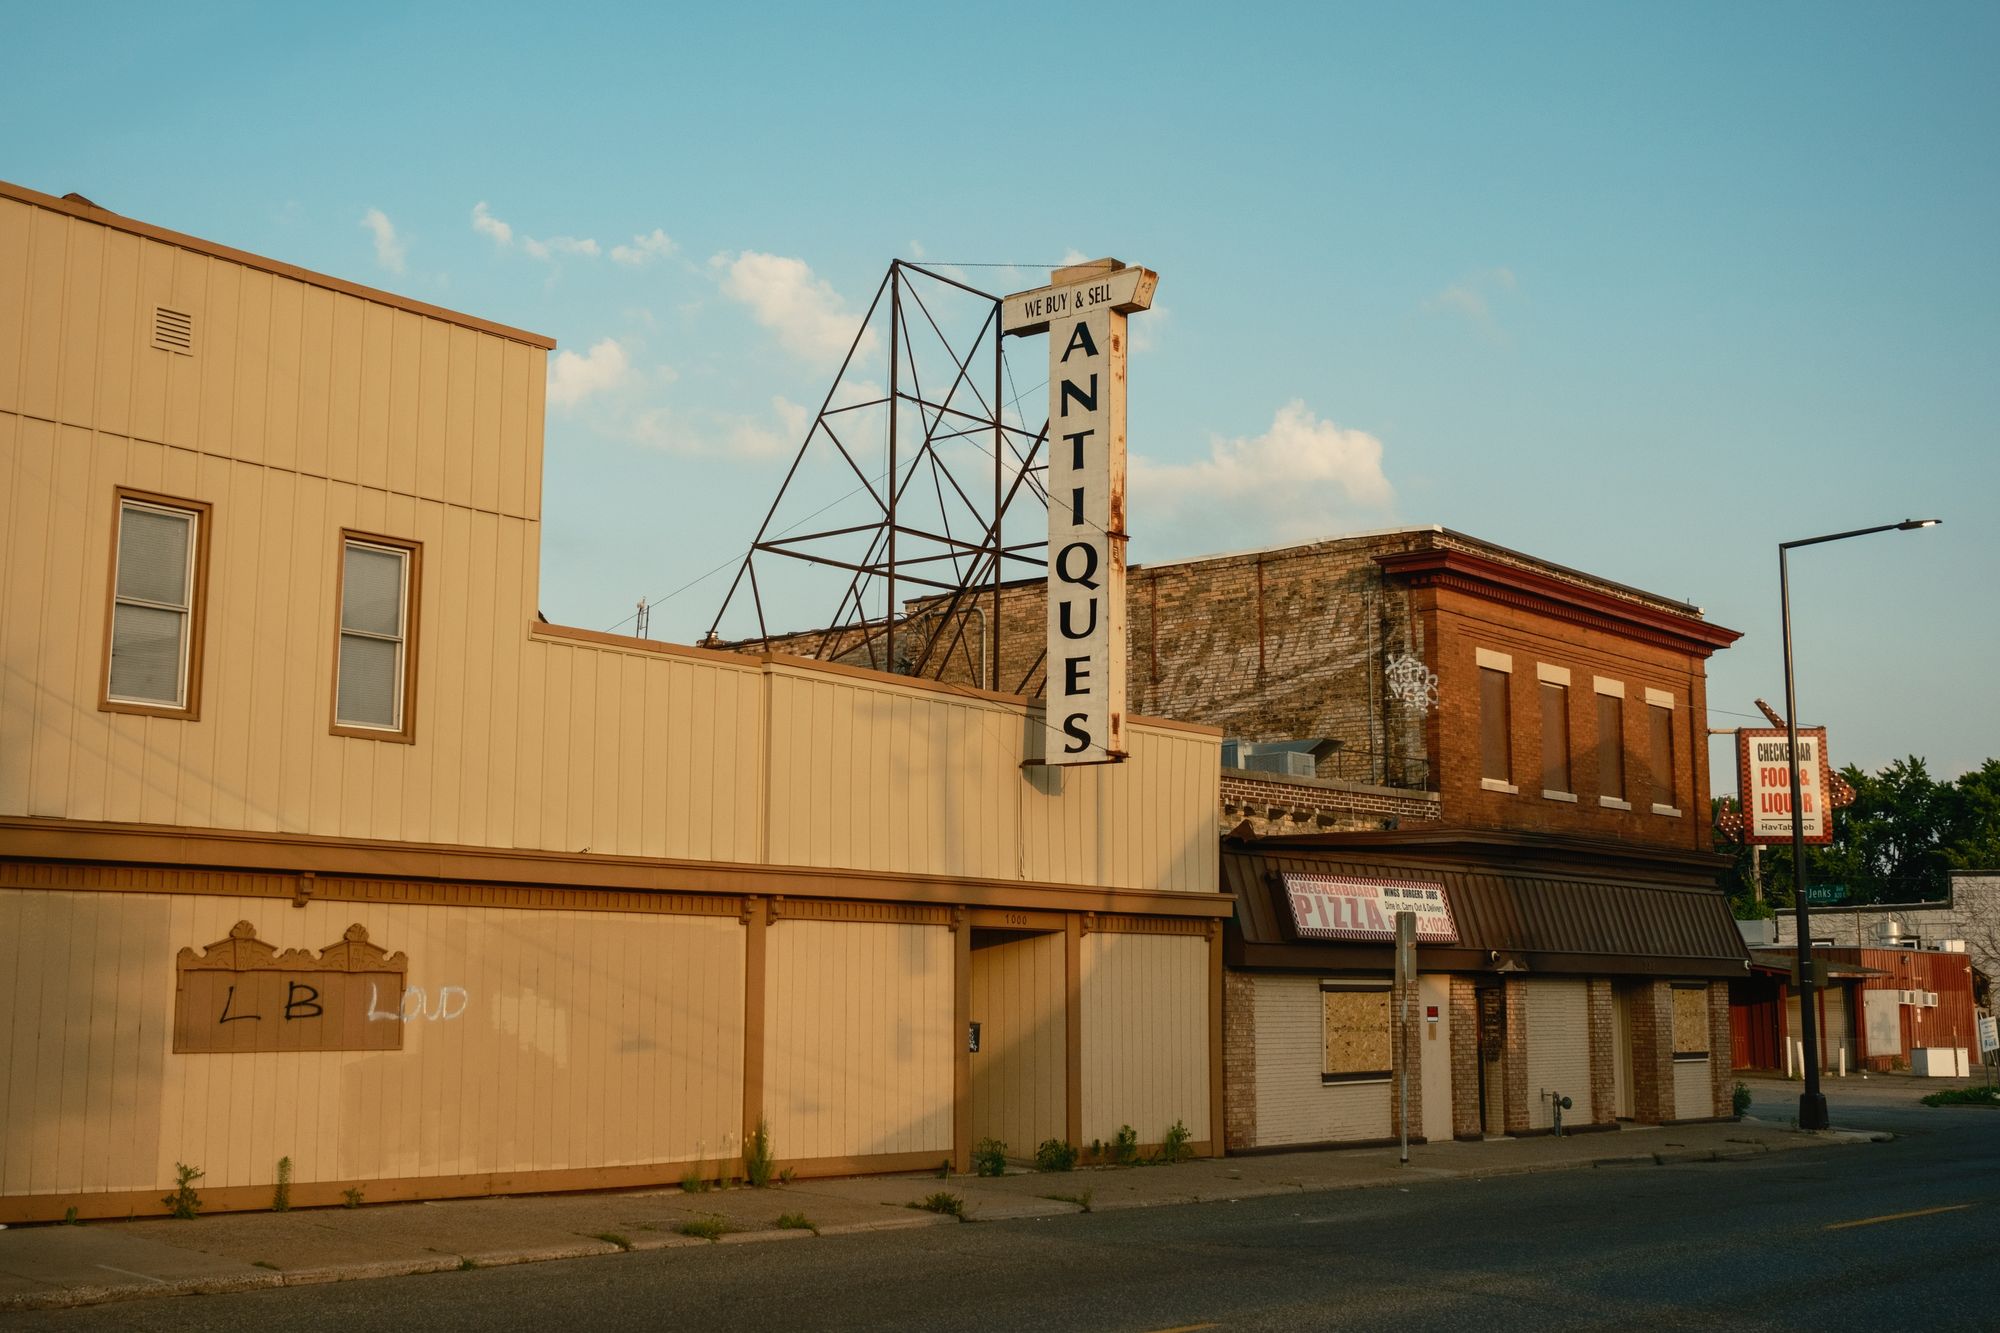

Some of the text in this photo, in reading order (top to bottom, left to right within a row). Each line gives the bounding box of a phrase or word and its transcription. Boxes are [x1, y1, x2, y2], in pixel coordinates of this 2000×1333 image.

[1025, 284, 1112, 319] WE BUY & SELL
[1055, 321, 1100, 754] ANTIQUES
[1757, 742, 1811, 762] CHECKEAR
[1760, 767, 1810, 788] FOO &
[1761, 792, 1813, 815] LIQUR
[1290, 881, 1379, 898] CHECKERBOARD
[1383, 887, 1438, 900] WINGS BURGERS SUBS
[1808, 887, 1832, 899] Jenks
[1292, 894, 1386, 930] PIZZA
[1384, 901, 1396, 910] Dine
[1402, 902, 1414, 912] Carry
[1414, 903, 1422, 911] Out
[1427, 904, 1444, 915] Delivery
[1005, 914, 1028, 925] 1000
[284, 980, 323, 1024] B
